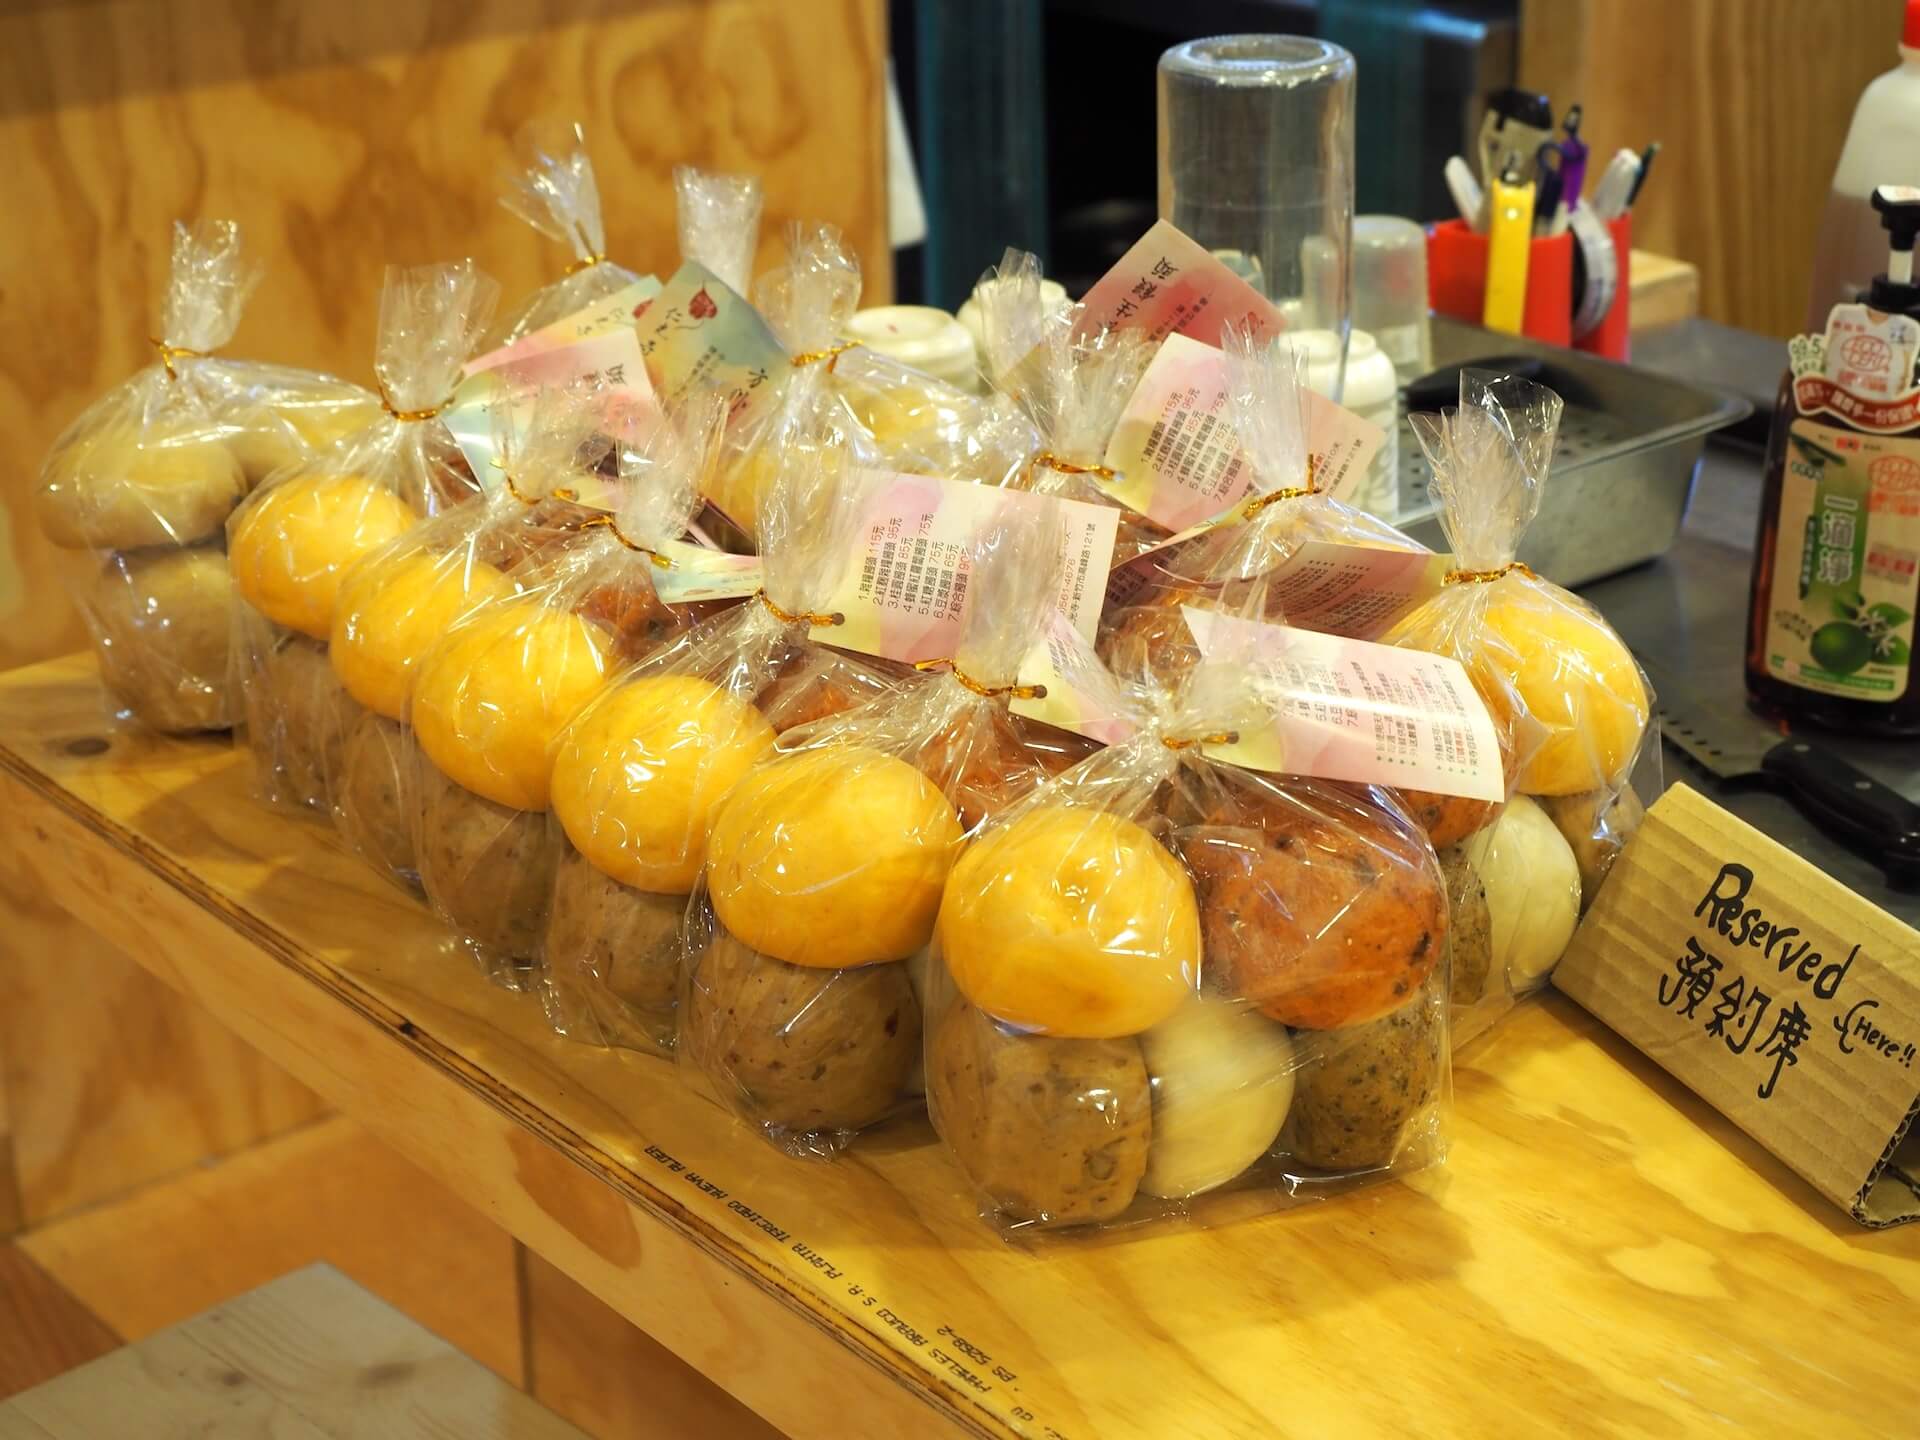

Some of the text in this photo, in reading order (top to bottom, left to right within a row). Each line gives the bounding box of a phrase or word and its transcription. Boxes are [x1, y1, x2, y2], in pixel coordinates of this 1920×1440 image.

[887, 517, 902, 540] 95元
[919, 512, 934, 536] 75元
[869, 525, 885, 555] 115元
[898, 537, 913, 560] 85元
[930, 542, 944, 564] 75元
[945, 544, 960, 567] 65元
[1694, 863, 1861, 1000] Reserved
[1658, 936, 1812, 1099] 預約席
[792, 1243, 843, 1280] PLANTA
[876, 1308, 929, 1347] ARAUCO
